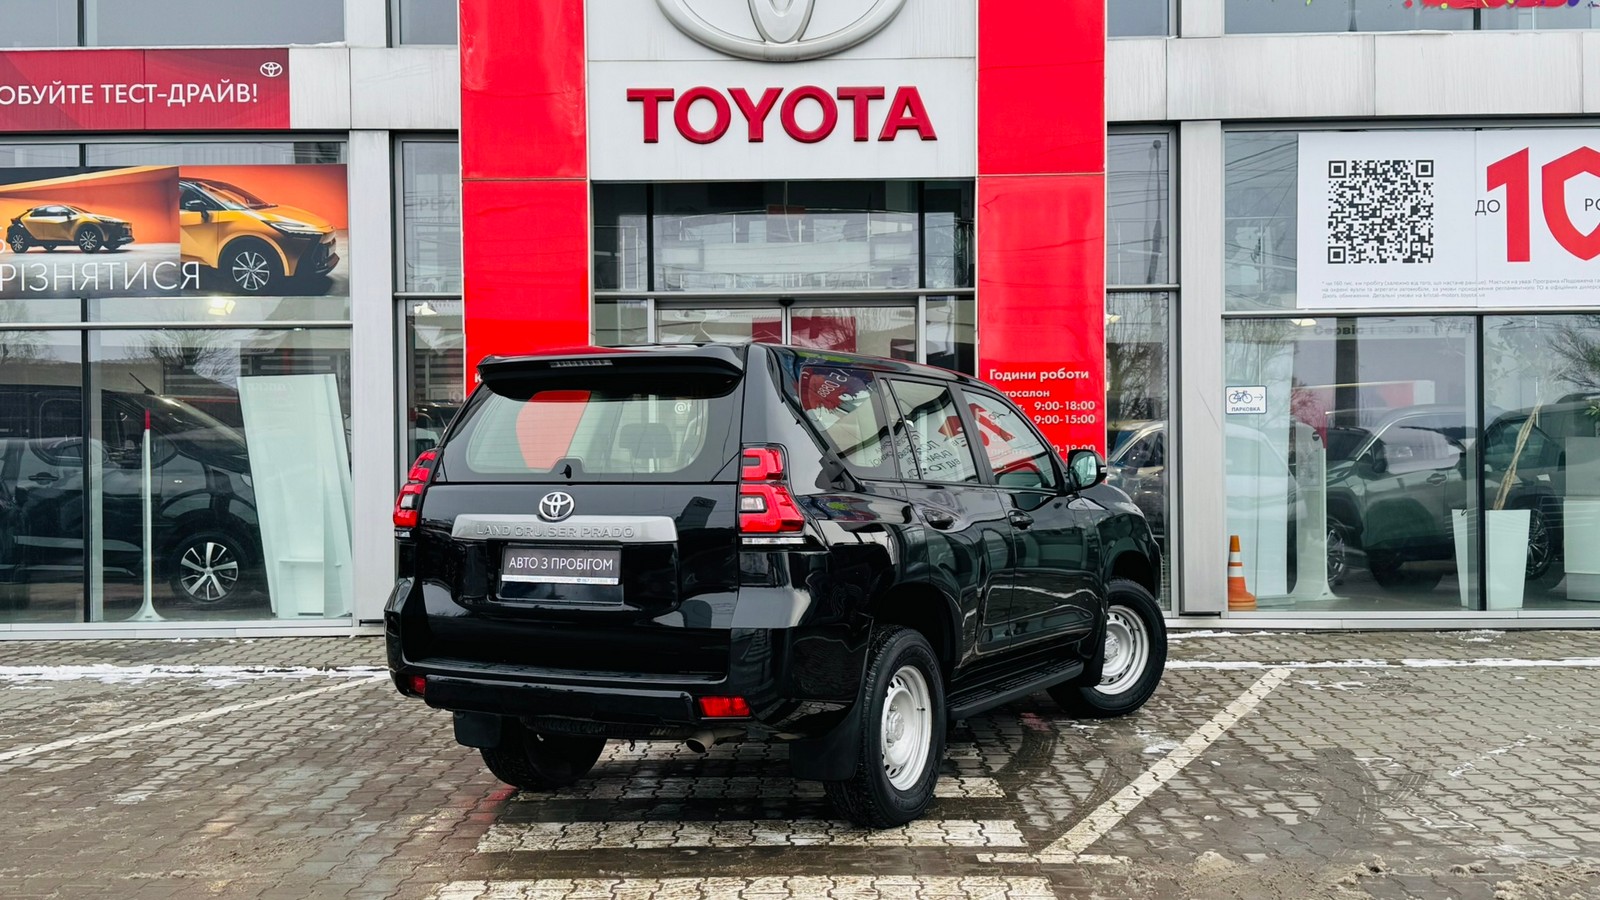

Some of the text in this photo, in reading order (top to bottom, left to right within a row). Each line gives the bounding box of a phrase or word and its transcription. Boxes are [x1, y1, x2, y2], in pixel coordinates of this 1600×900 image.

[0, 78, 258, 107] ОБУЙТЕ ТЕСТ-ДРАЙВ!
[626, 85, 937, 144] TOYOTA
[1475, 199, 1501, 216] ДО
[1487, 146, 1600, 262] 10
[0, 262, 200, 292] РІЗНЯТИСЯ
[989, 368, 1089, 382] Години роботи
[1004, 390, 1050, 398] тосалон
[1034, 400, 1095, 411] 9:00-18:00
[1034, 414, 1096, 425] 9:00-15:00
[475, 524, 635, 539] LAND CRUISER PRADO
[508, 557, 539, 569] АВТО
[551, 557, 613, 571] ПРОБІГОМ
